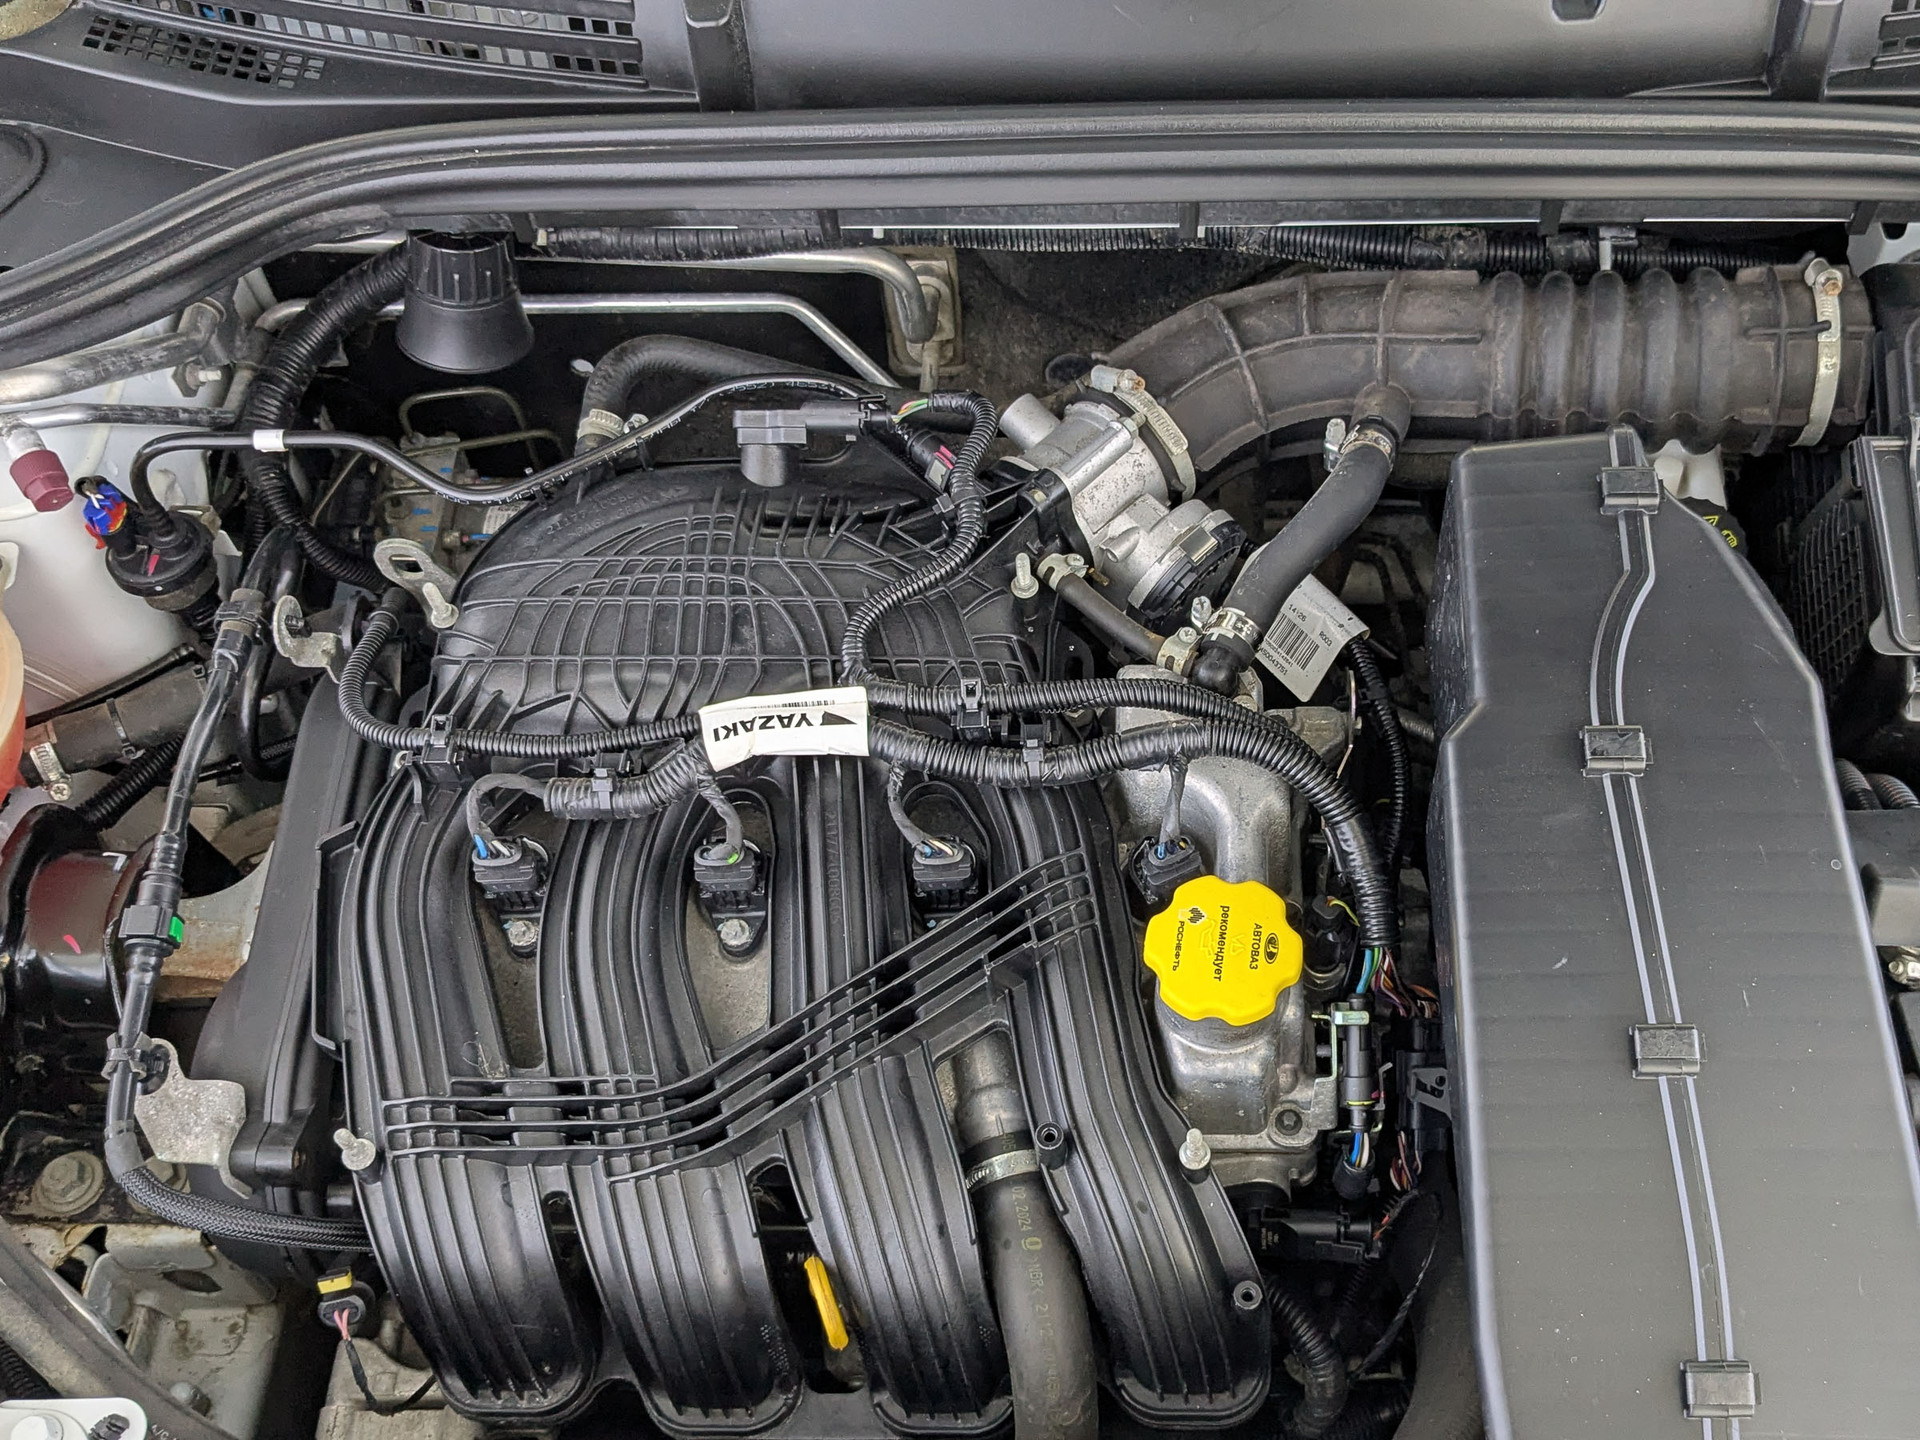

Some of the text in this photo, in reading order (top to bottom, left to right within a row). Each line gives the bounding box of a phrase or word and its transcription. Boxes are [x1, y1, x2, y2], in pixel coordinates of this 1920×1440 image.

[713, 712, 814, 743] YAZAKI
[1172, 920, 1185, 972] РОСНЕФТЬ
[1212, 905, 1231, 982] рекомендует
[1249, 922, 1263, 970] АВТОВАЗ
[1011, 1186, 1033, 1232] 02.2024
